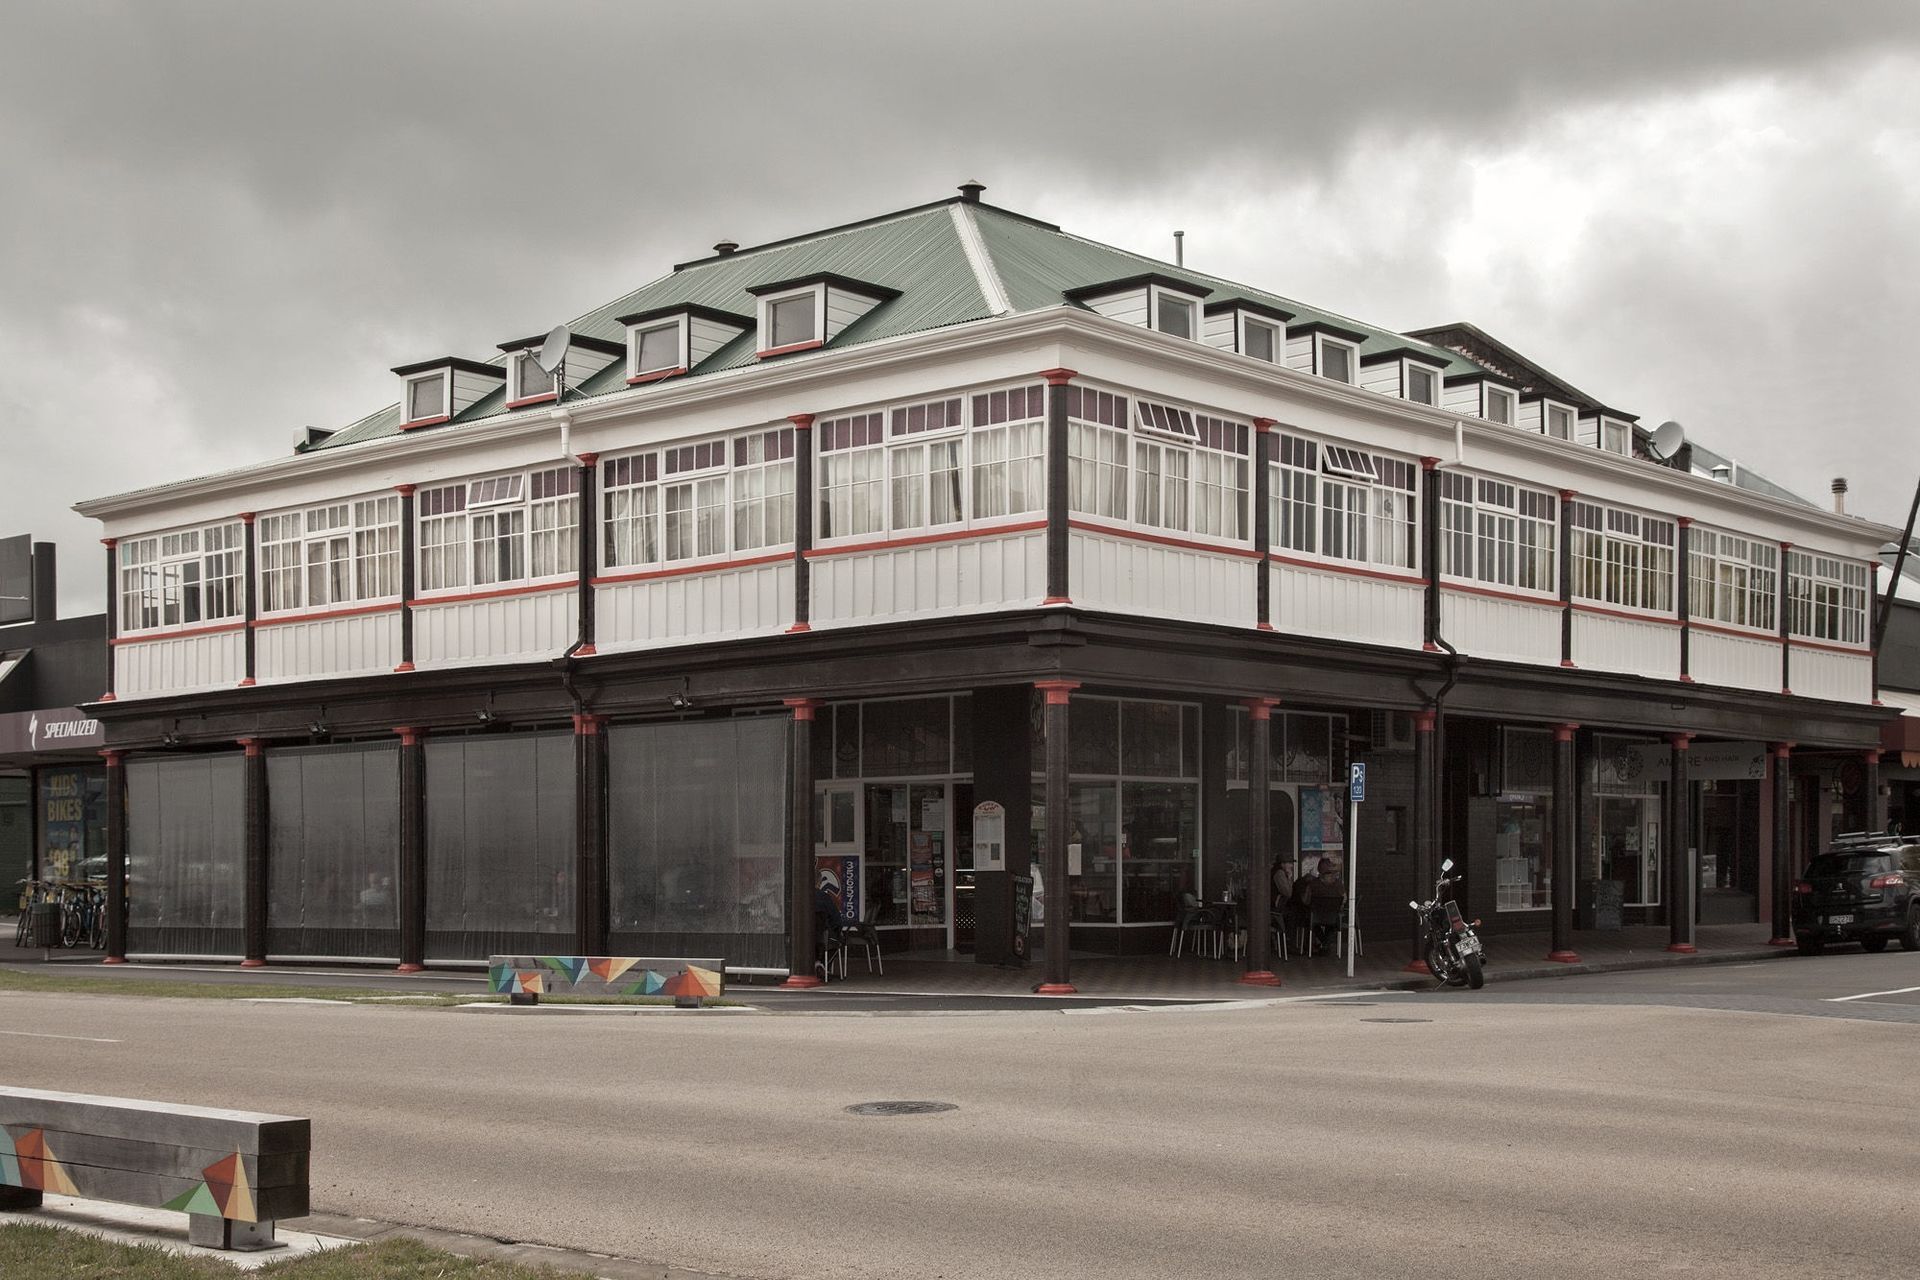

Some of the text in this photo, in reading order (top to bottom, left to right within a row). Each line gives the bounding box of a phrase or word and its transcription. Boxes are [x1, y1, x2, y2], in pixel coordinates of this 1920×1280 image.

[43, 719, 98, 739] SPECIALIZED
[50, 774, 78, 797] KIDS
[47, 799, 83, 822] BIKES
